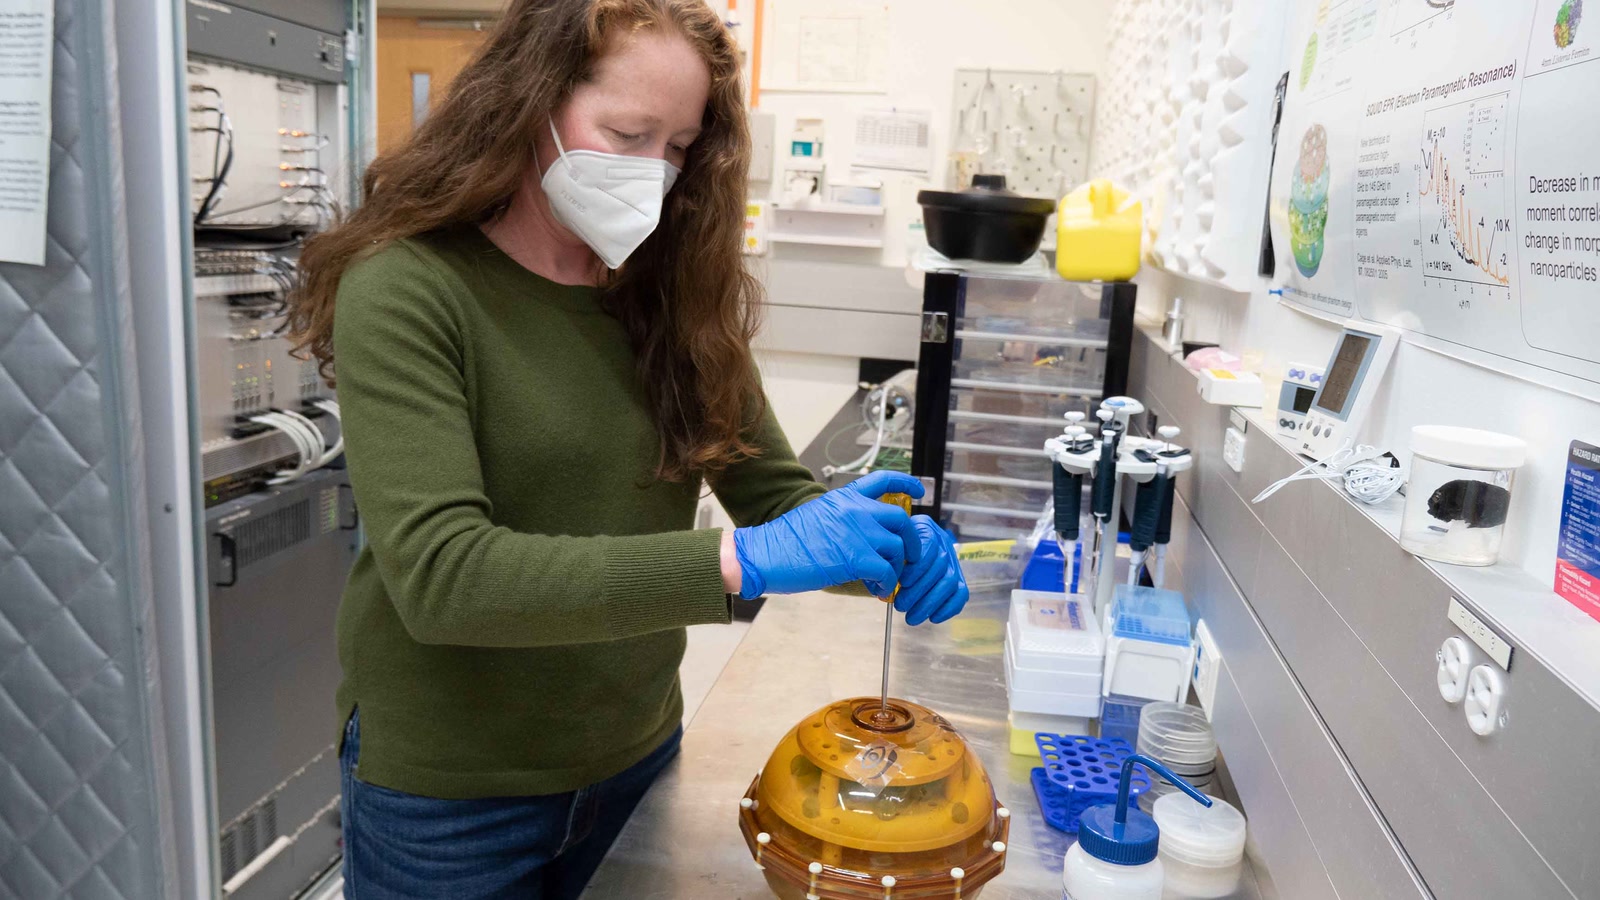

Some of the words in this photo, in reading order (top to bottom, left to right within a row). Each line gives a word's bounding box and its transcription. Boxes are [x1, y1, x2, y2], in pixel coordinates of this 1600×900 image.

[1420, 76, 1466, 102] Paramagnetic
[1468, 59, 1517, 88] Resonance)
[1530, 176, 1576, 194] Decrease
[1580, 172, 1589, 192] in
[1526, 204, 1566, 222] moment
[1568, 202, 1600, 222] correl
[1496, 219, 1503, 231] 10
[1504, 219, 1510, 232] K
[1525, 231, 1560, 254] change
[1562, 232, 1571, 250] in
[1530, 262, 1597, 282] nanoparticles
[1572, 447, 1591, 460] HAZARD
